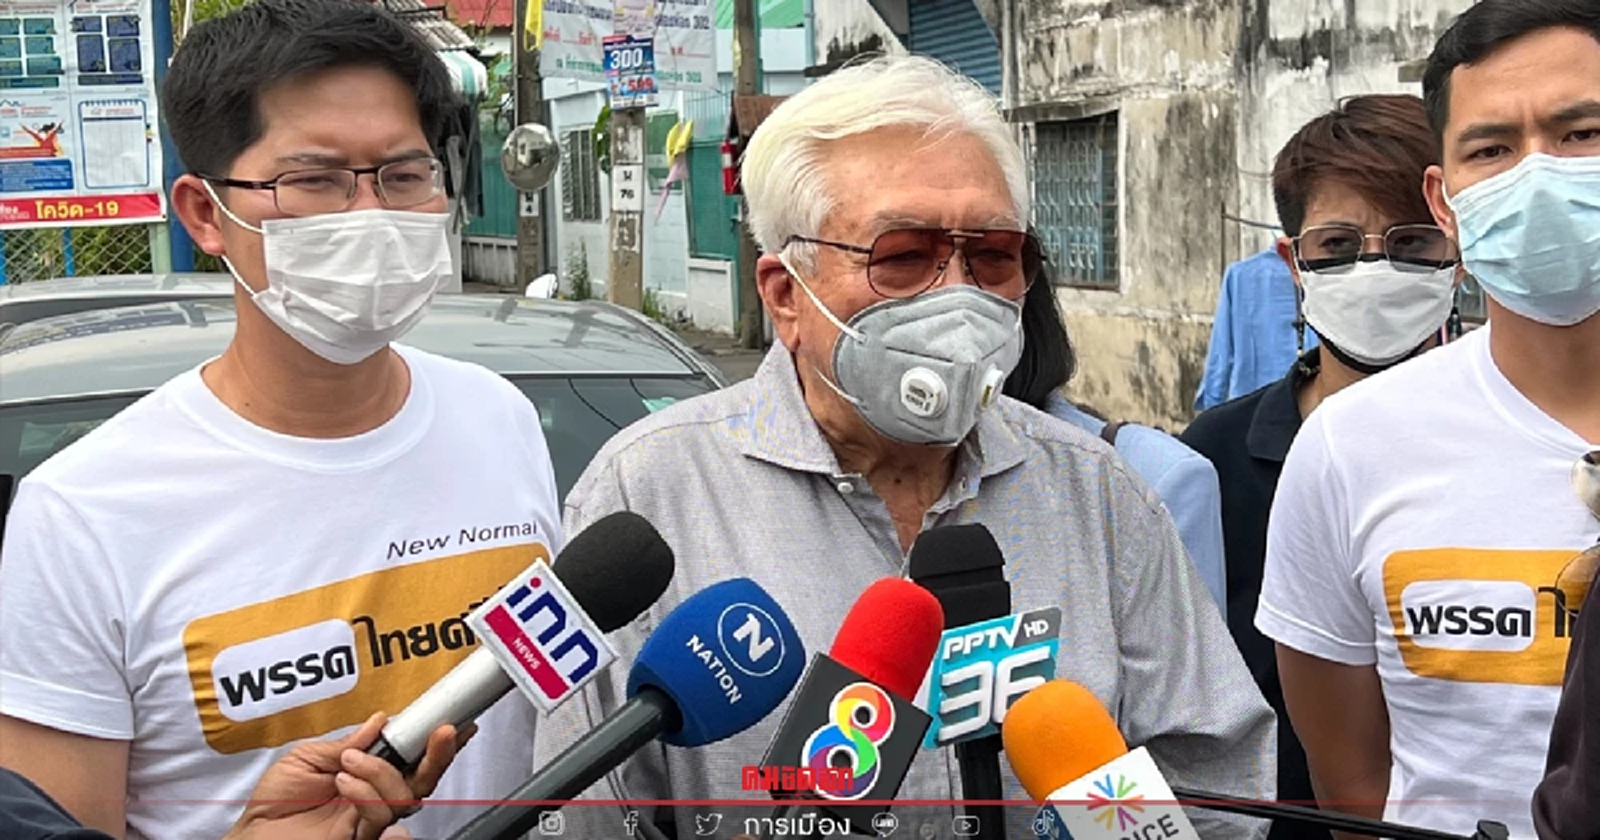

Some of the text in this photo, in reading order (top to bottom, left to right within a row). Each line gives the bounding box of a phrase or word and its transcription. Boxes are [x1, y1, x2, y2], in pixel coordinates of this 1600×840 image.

[610, 47, 643, 69] 300
[35, 199, 119, 219] โควิด-19
[386, 535, 451, 560] New
[942, 612, 1049, 660] PPTV HD
[511, 638, 542, 670] NEWS
[685, 634, 743, 705] NATION
